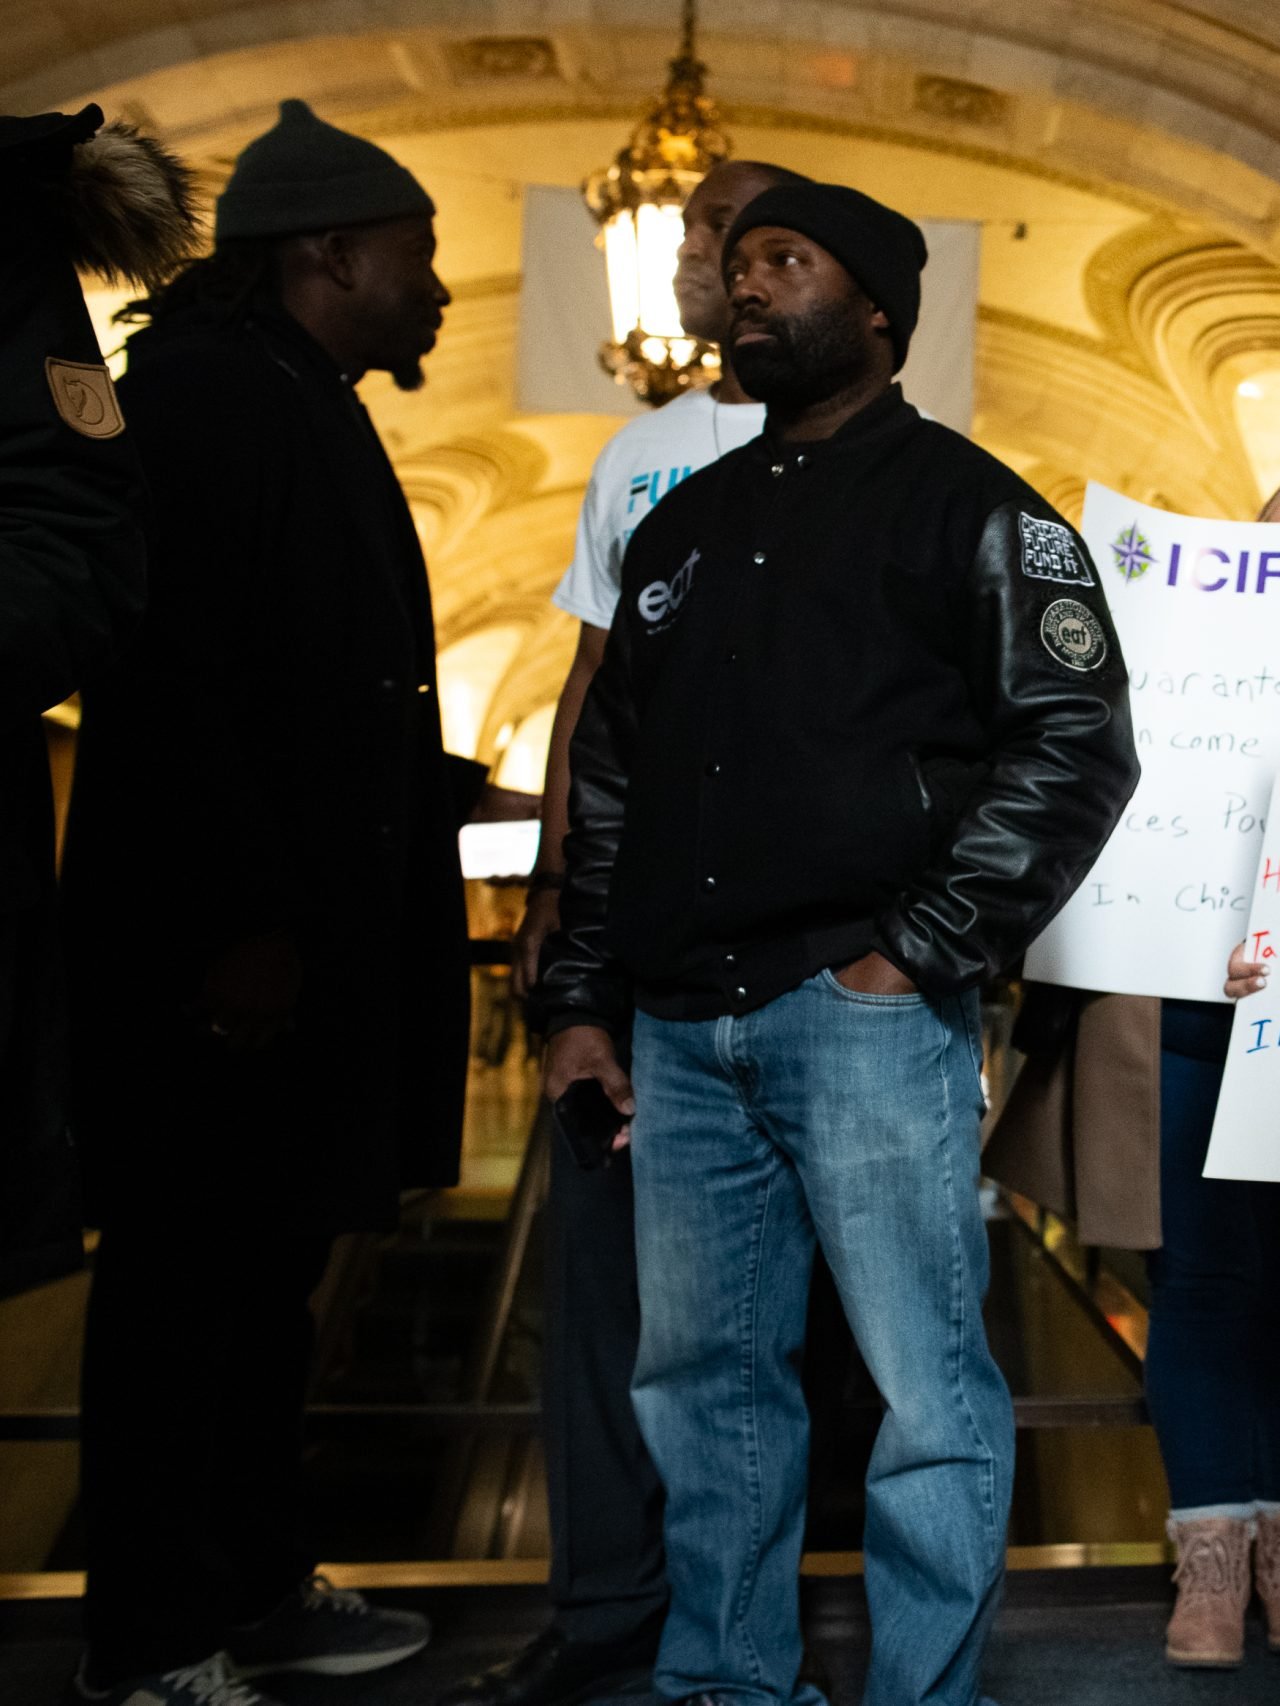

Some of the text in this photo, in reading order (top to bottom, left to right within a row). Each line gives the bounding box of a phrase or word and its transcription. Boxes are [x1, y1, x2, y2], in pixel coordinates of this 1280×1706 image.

[628, 466, 691, 513] FU
[1023, 532, 1073, 557] FUTURE
[1025, 548, 1062, 569] FUND
[638, 548, 701, 622] eat
[1061, 625, 1087, 646] eat
[1174, 883, 1248, 912] Chic
